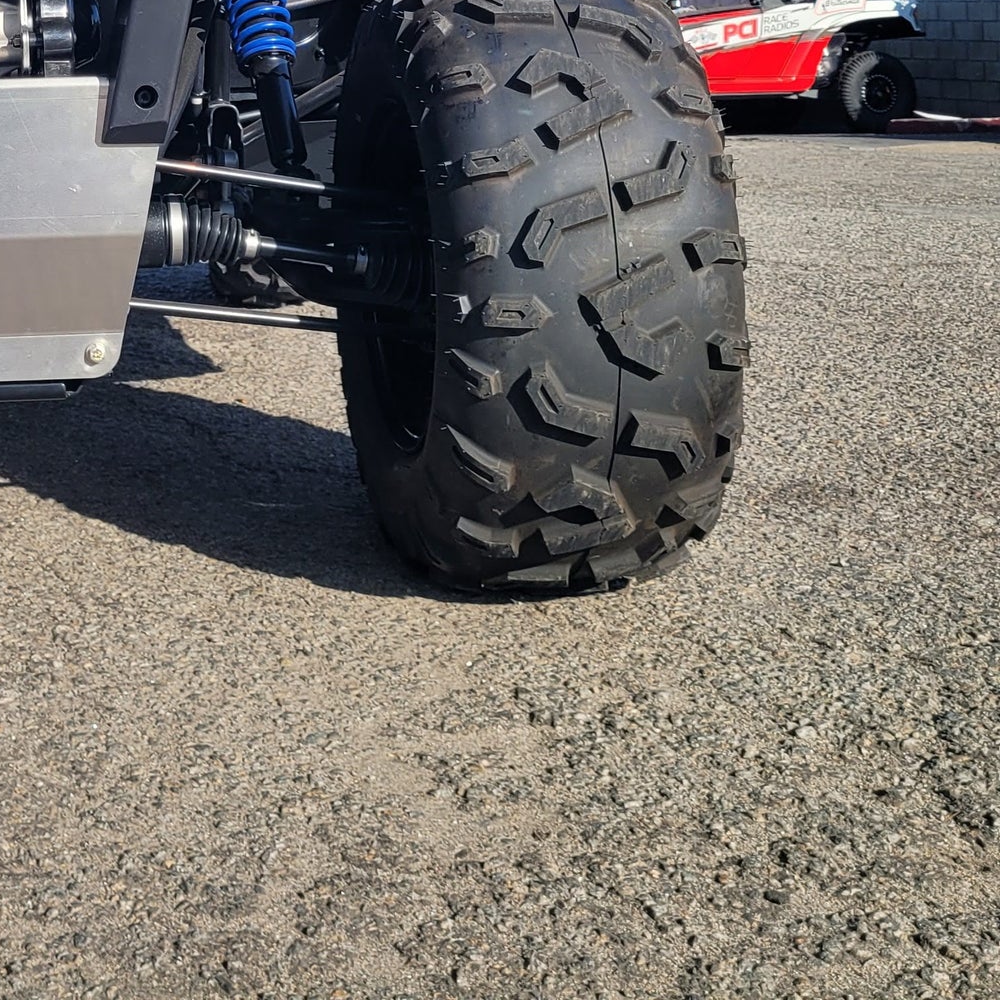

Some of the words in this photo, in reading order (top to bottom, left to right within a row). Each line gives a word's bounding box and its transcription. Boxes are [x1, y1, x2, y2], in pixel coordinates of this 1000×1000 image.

[764, 12, 789, 24] RACE
[724, 18, 758, 43] PCI
[764, 20, 800, 34] RADIOS
